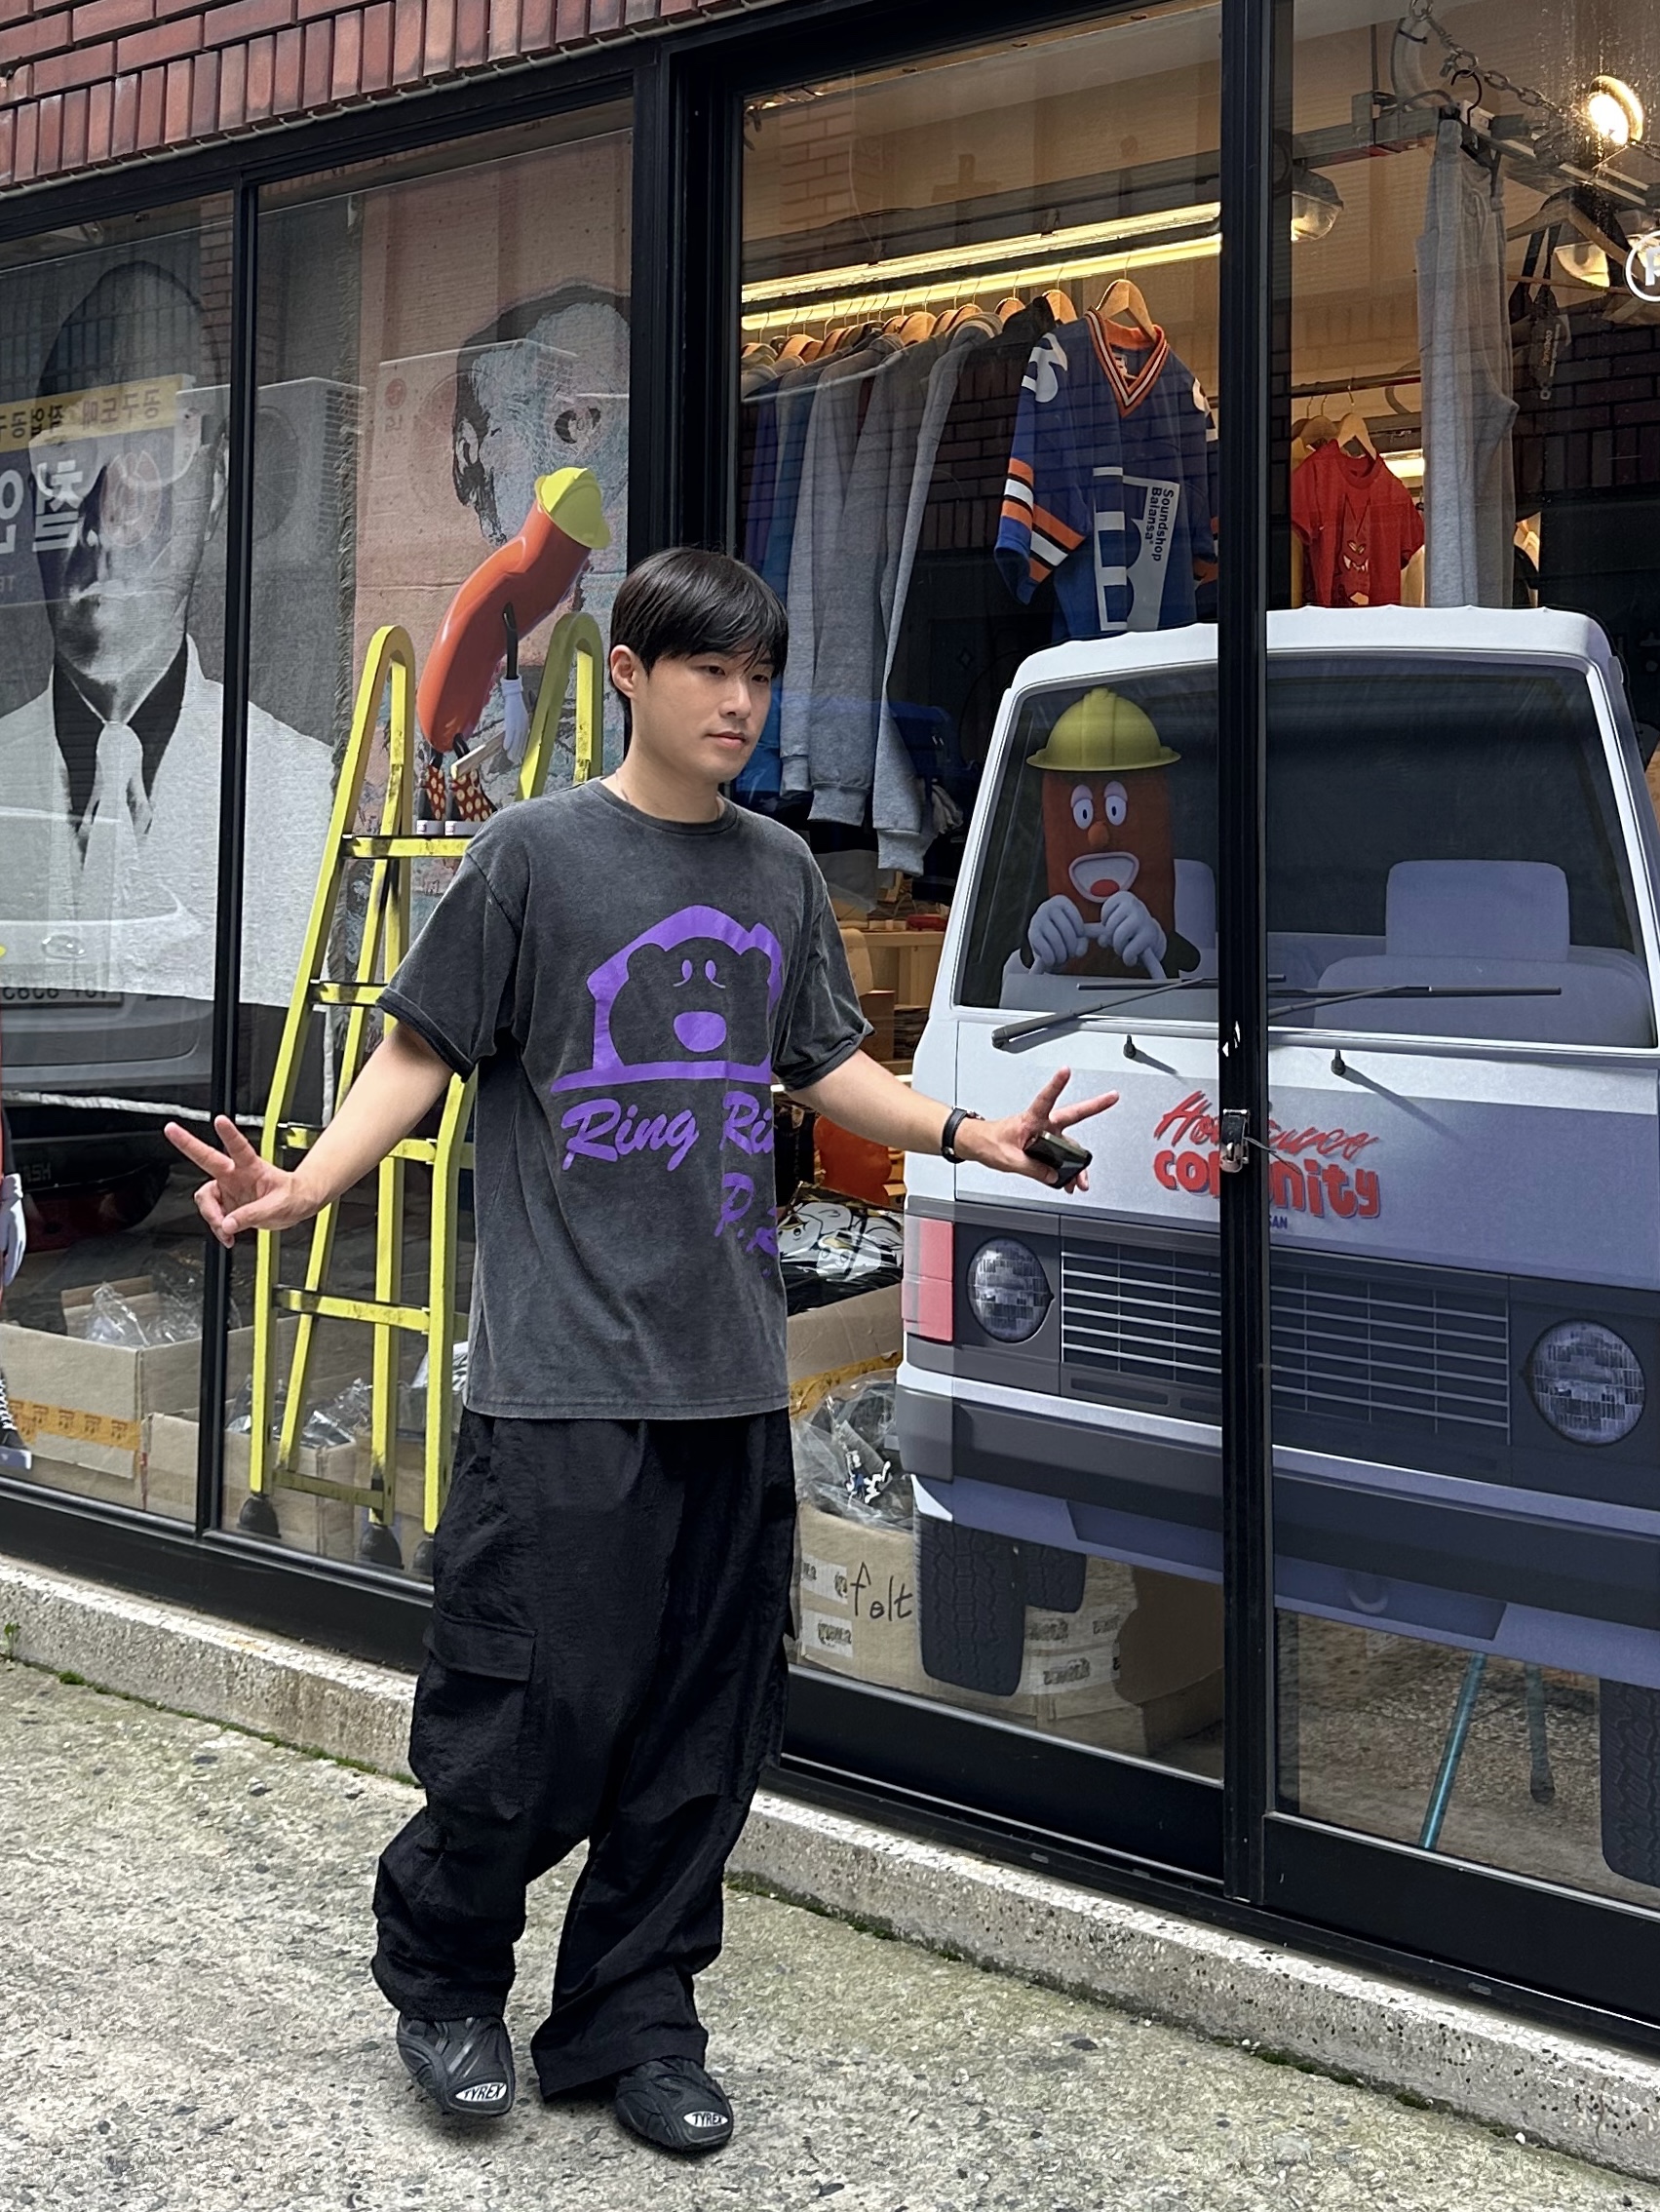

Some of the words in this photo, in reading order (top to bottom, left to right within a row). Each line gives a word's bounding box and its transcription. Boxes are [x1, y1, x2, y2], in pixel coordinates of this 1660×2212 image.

[1151, 488, 1175, 563] Soundshop
[561, 1099, 699, 1171] Ring
[463, 2083, 506, 2101] TYREX
